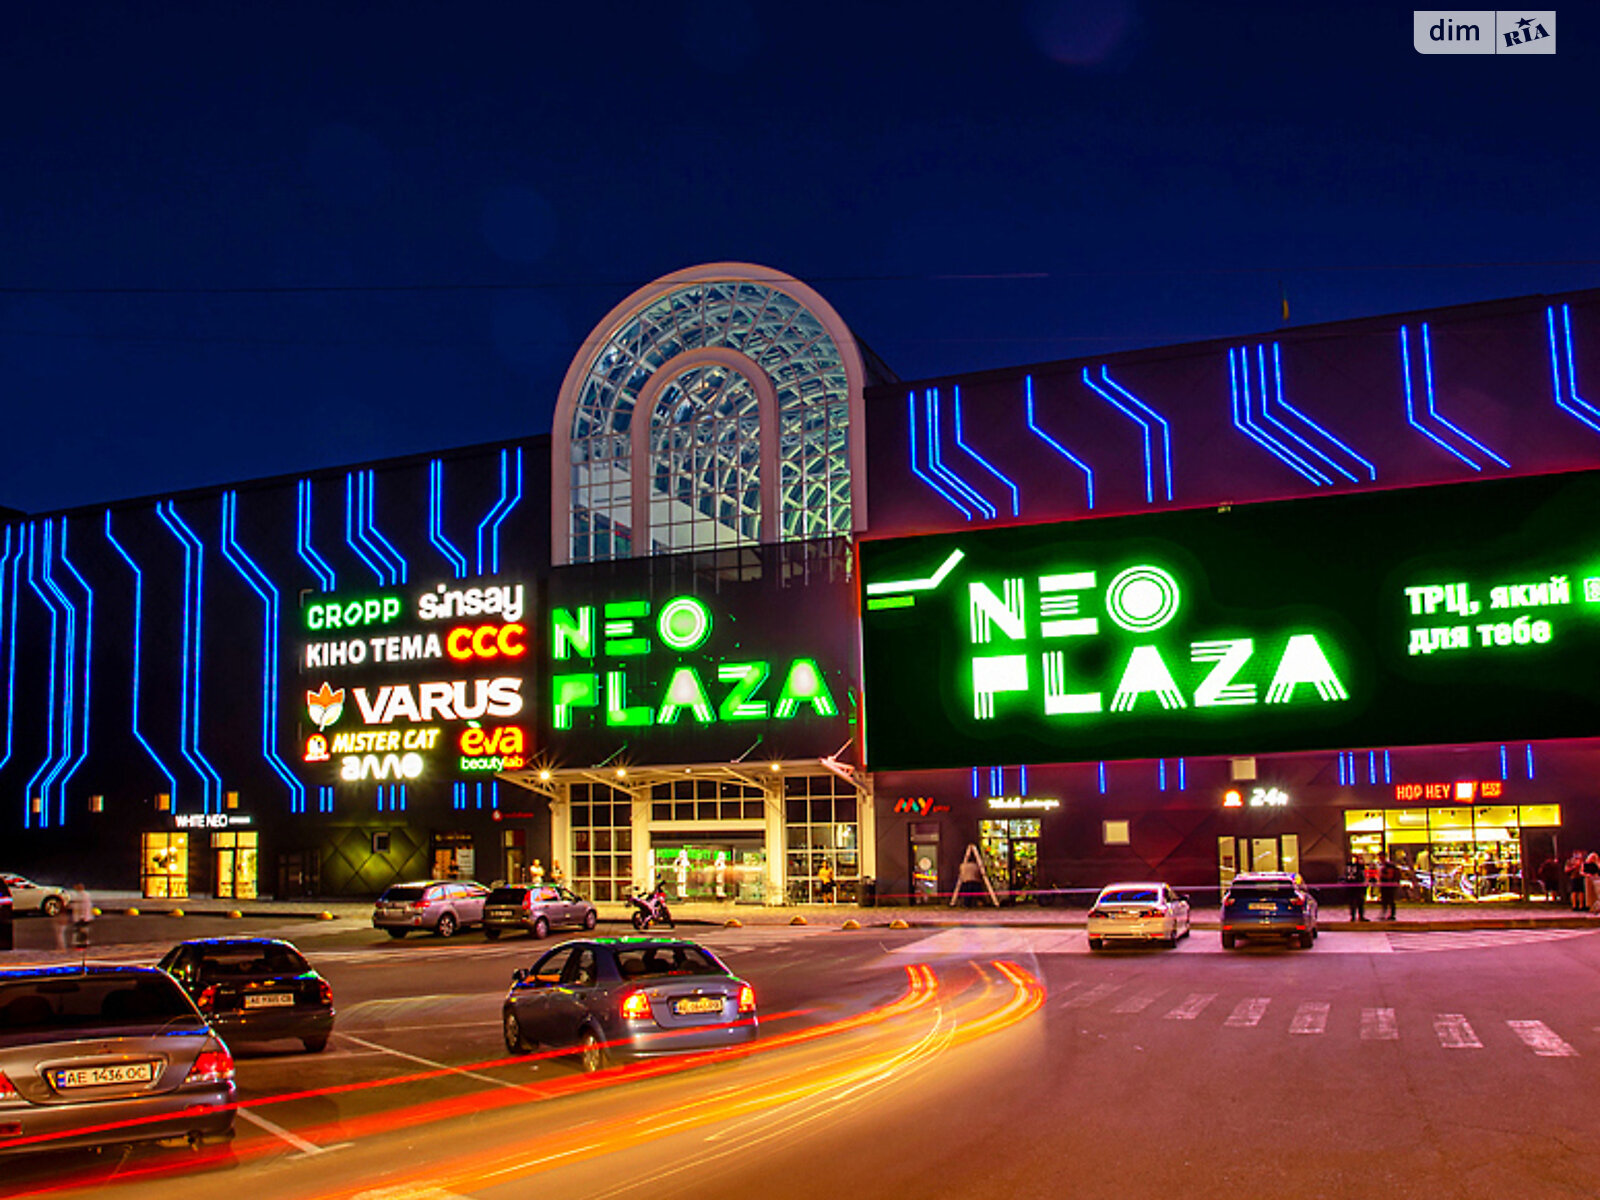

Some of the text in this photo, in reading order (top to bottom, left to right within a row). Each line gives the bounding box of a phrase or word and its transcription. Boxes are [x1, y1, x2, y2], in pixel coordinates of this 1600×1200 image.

[307, 597, 401, 630] CROPP
[418, 583, 525, 622] sinsay
[968, 564, 1181, 643] NEO
[1404, 582, 1482, 616] ТРЦ,
[1490, 574, 1572, 609] який
[446, 623, 526, 661] CCC
[551, 594, 713, 660] NEO
[1408, 615, 1553, 656] для тебе
[369, 633, 443, 663] ТЕМА
[552, 658, 839, 730] PLAZA
[971, 633, 1350, 721] PLAZA
[351, 676, 524, 725] VARUS
[331, 728, 441, 753] MISTER CAT
[67, 1071, 88, 1084] AE
[126, 1066, 147, 1079] OC
